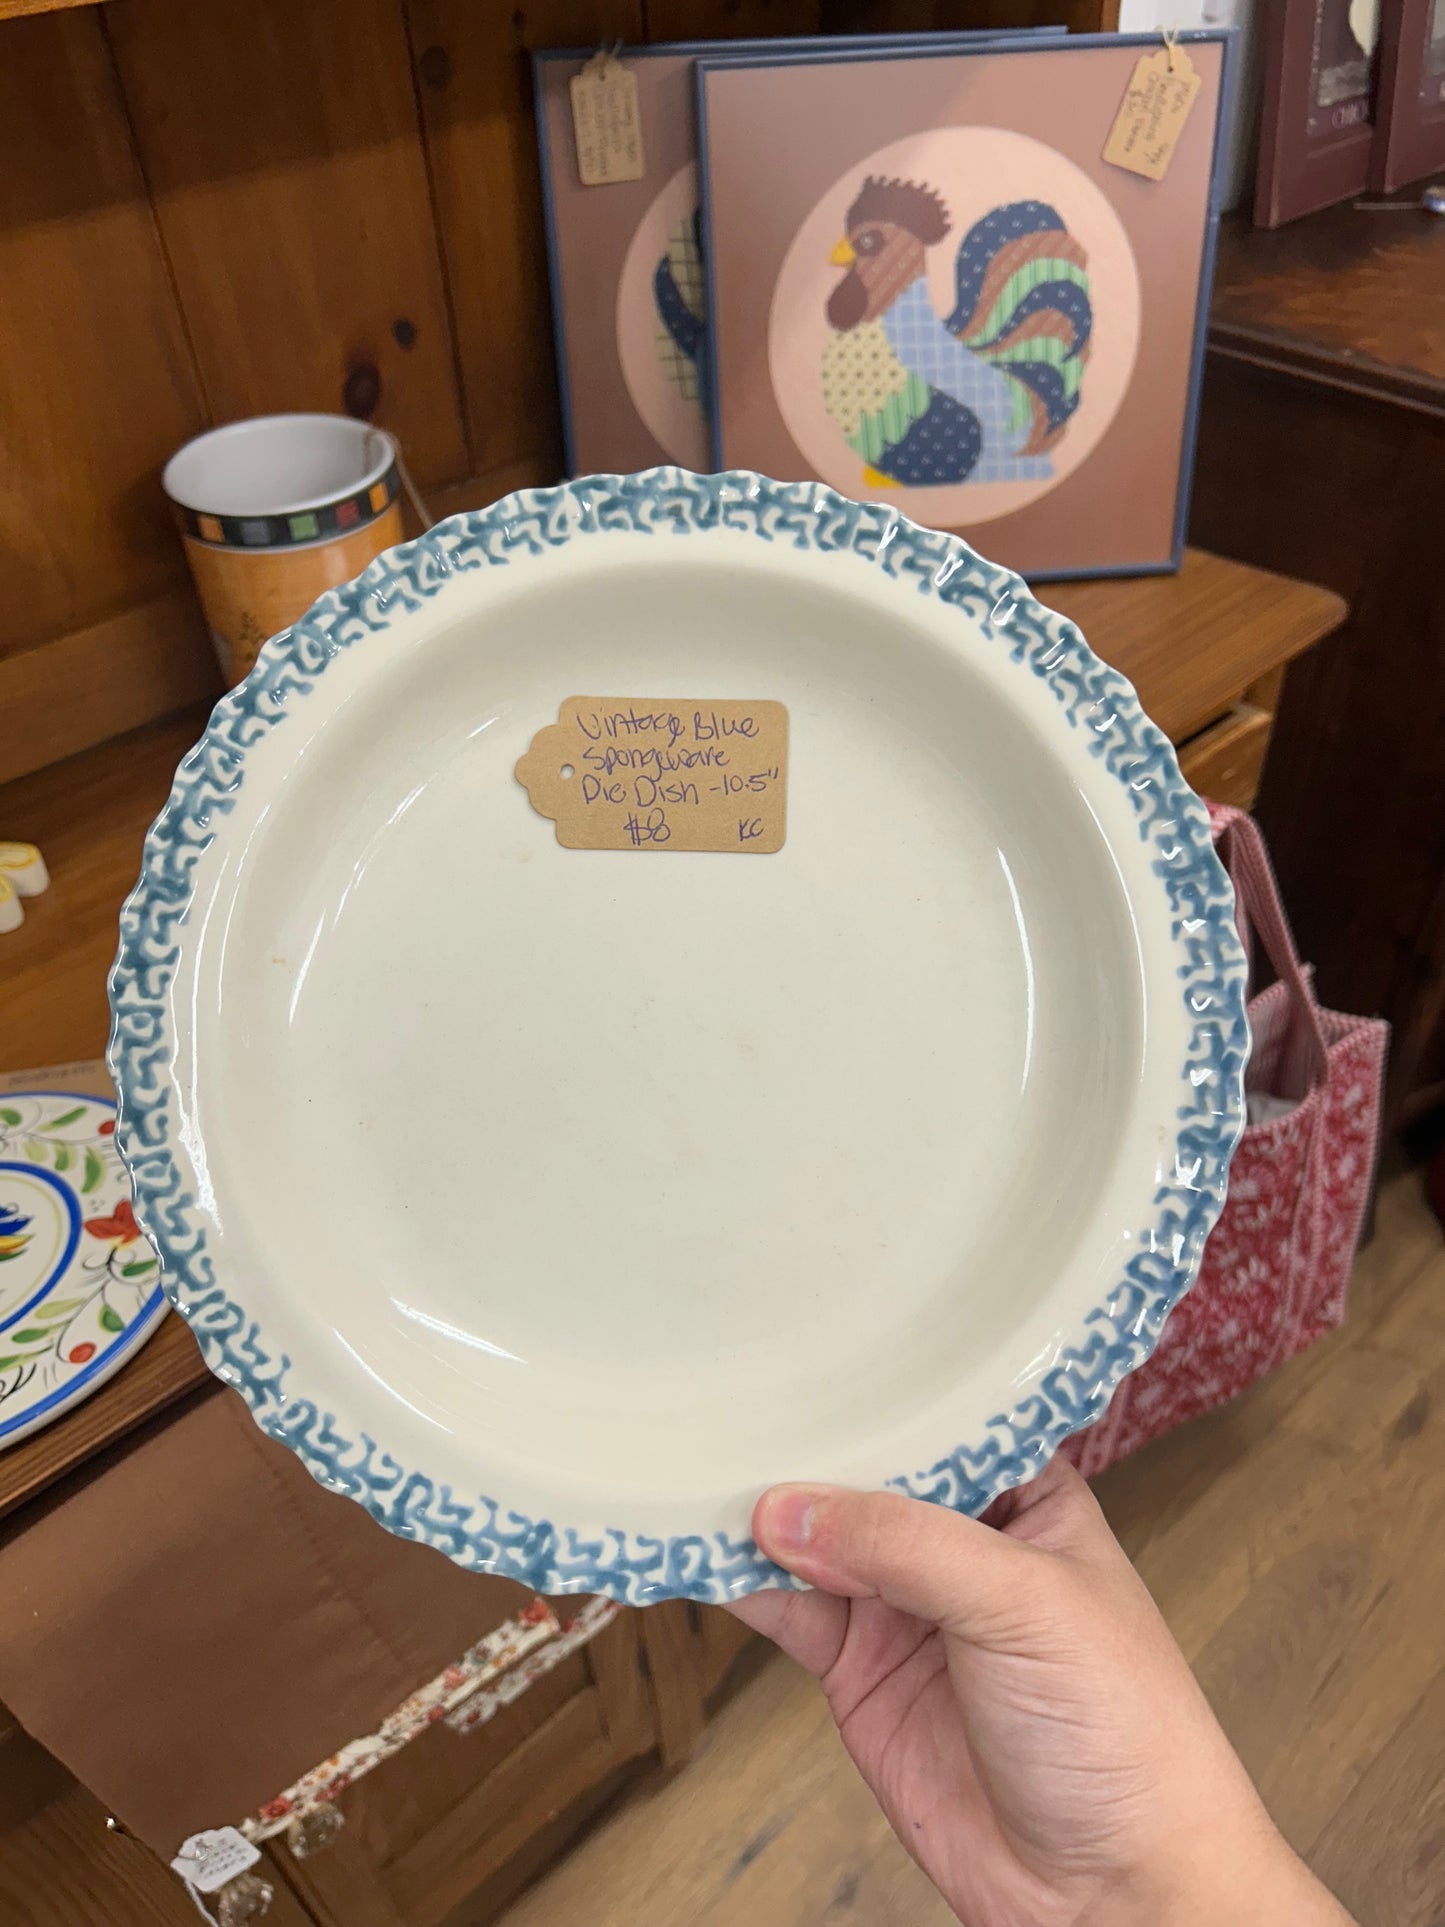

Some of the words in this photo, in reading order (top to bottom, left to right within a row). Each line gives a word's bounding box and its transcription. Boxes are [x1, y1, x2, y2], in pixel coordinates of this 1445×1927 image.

[577, 708, 686, 748] Vintage
[694, 712, 760, 741] Blue
[635, 775, 700, 808] Dish
[623, 808, 671, 846] $8
